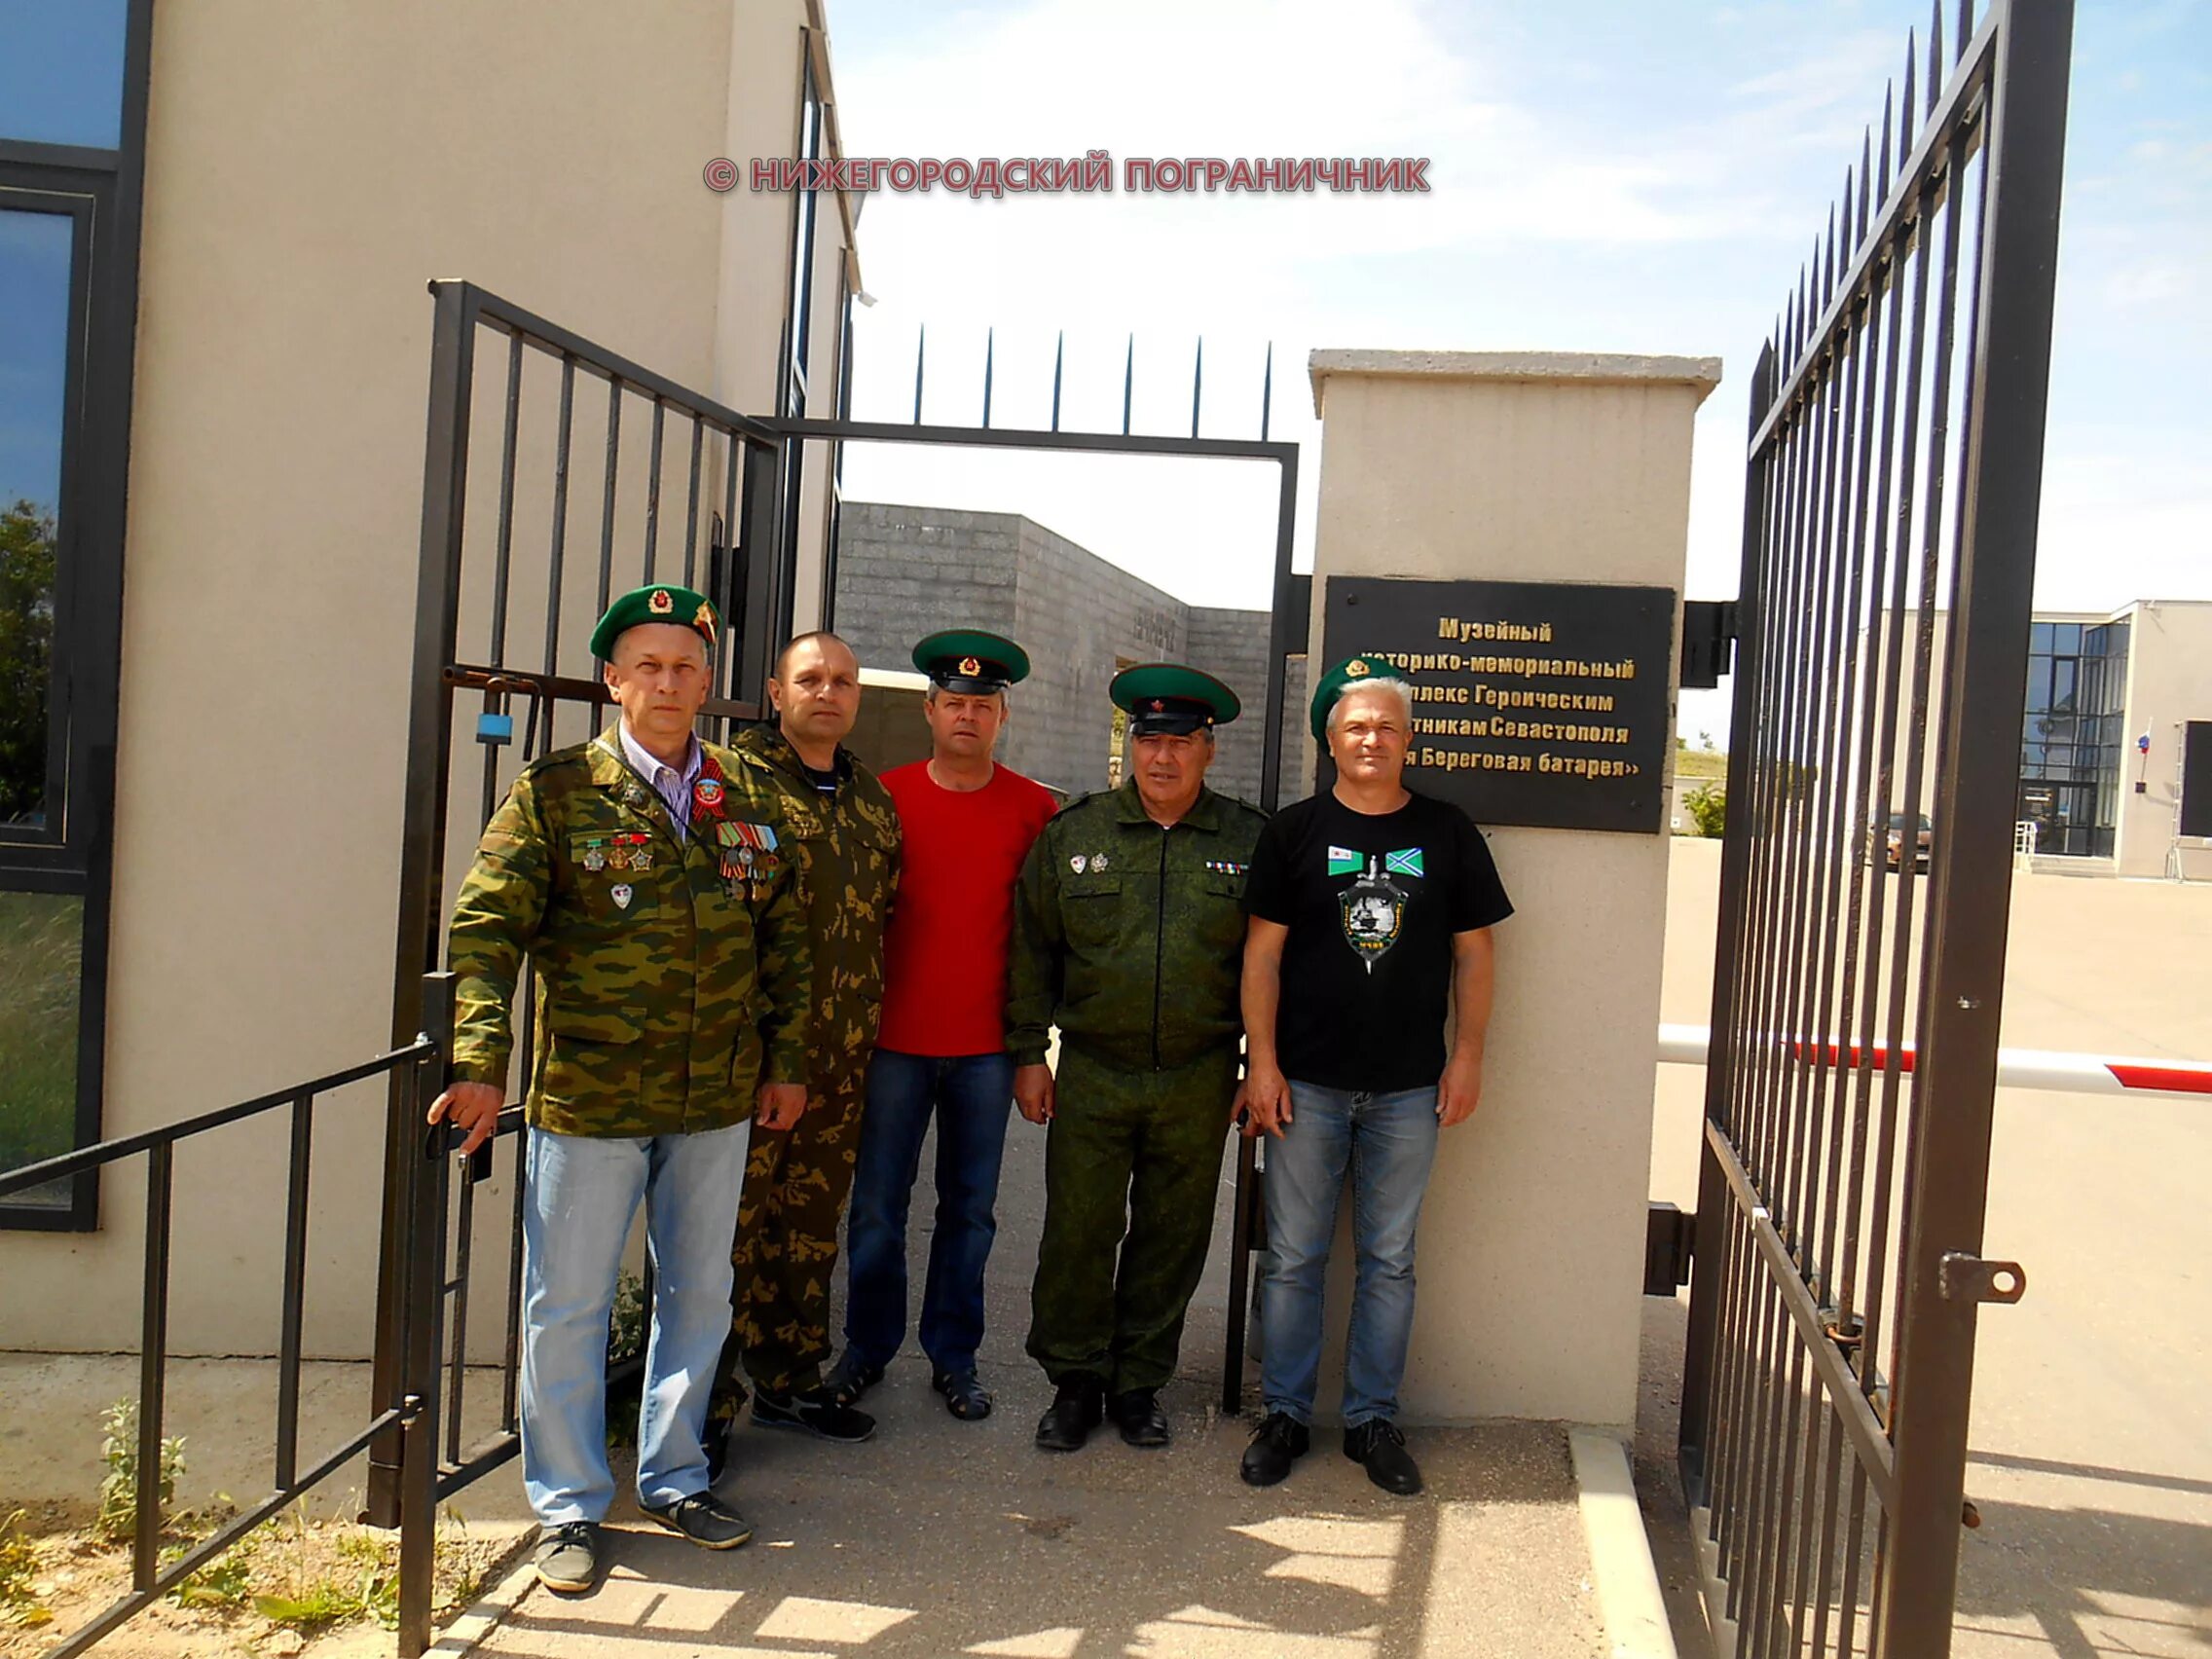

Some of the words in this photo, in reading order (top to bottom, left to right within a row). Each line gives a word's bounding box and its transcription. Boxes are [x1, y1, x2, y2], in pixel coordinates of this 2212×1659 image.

[1439, 617, 1552, 644] Музейный
[1361, 652, 1636, 680] торико-мемориальный
[1410, 684, 1470, 704] плекс
[1474, 685, 1614, 712] Героическим
[1413, 718, 1487, 737] тникам
[1491, 717, 1629, 744] Севастополя
[1421, 748, 1532, 771] Береговая
